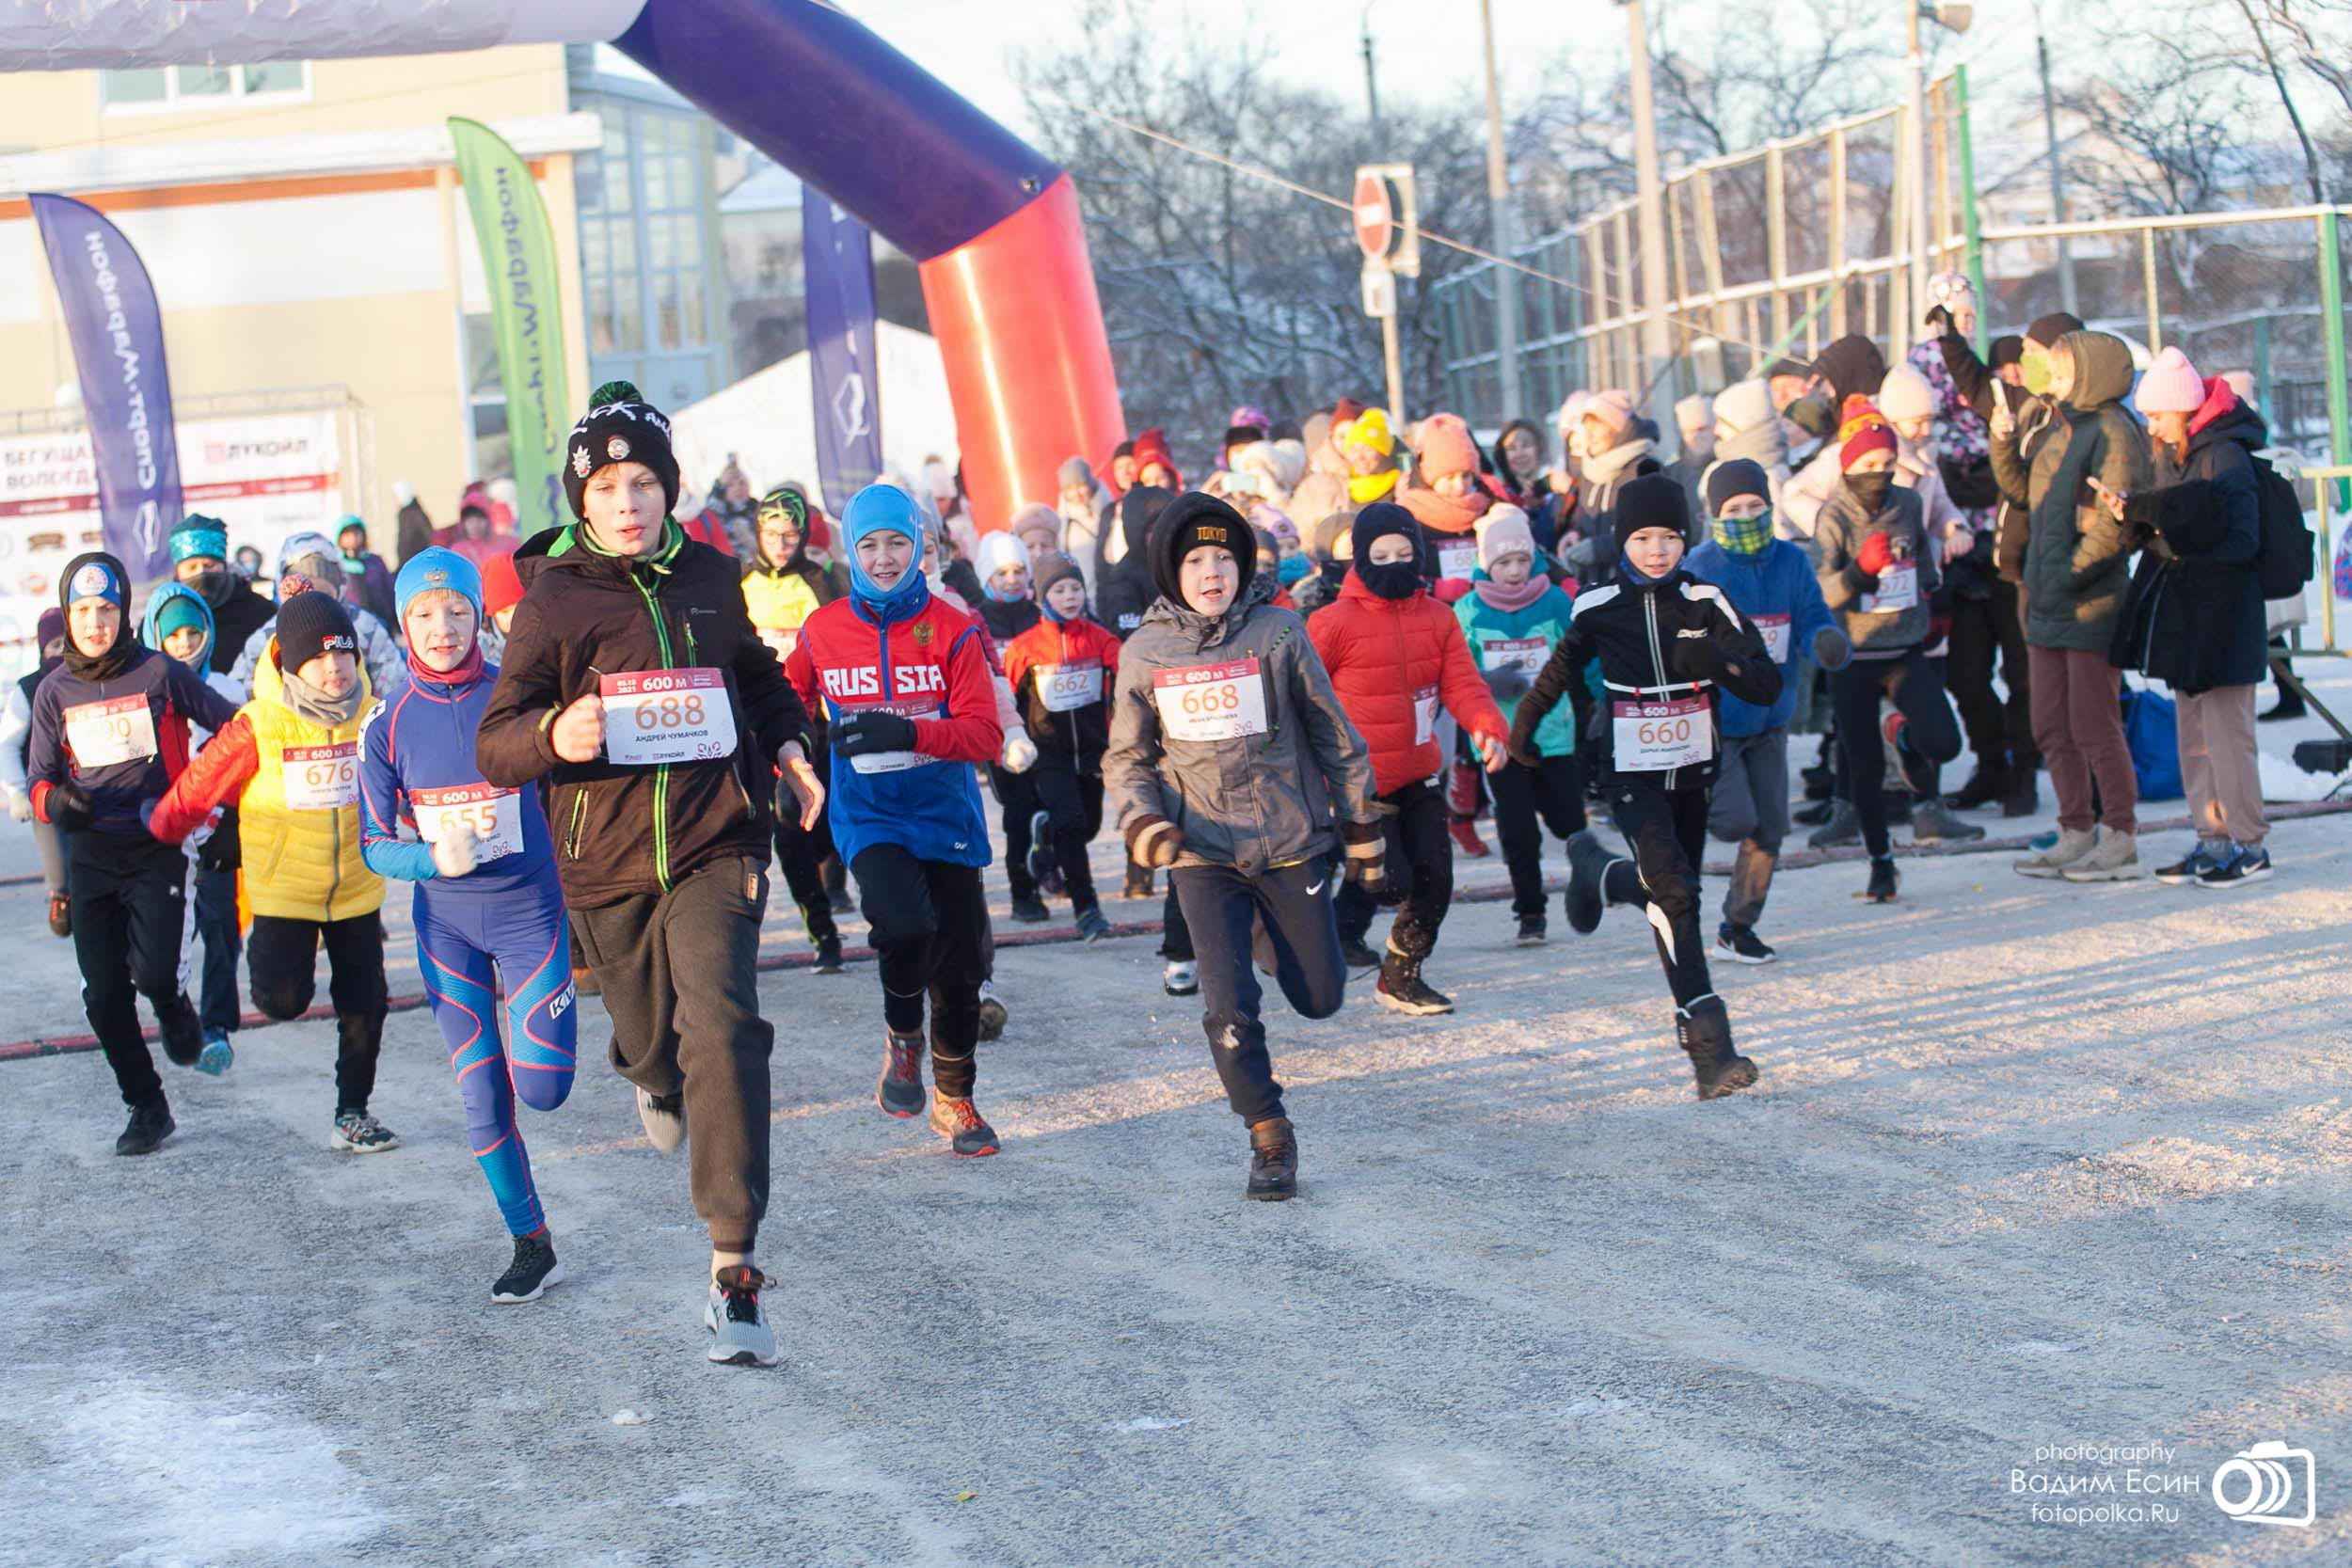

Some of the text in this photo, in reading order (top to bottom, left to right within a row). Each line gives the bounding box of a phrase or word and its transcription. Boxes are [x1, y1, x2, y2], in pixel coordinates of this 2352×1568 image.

[1196, 527, 1227, 542] TOKYO
[323, 634, 355, 650] FILA
[643, 676, 673, 691] 600
[1053, 673, 1089, 693] 662
[1185, 670, 1212, 683] 600
[1182, 684, 1239, 715] 668
[635, 694, 706, 731] 688
[1644, 706, 1669, 716] 600
[1639, 719, 1691, 744] 660
[310, 748, 333, 760] 600
[306, 760, 354, 786] 676
[442, 791, 469, 804] 600
[439, 804, 498, 832] 655
